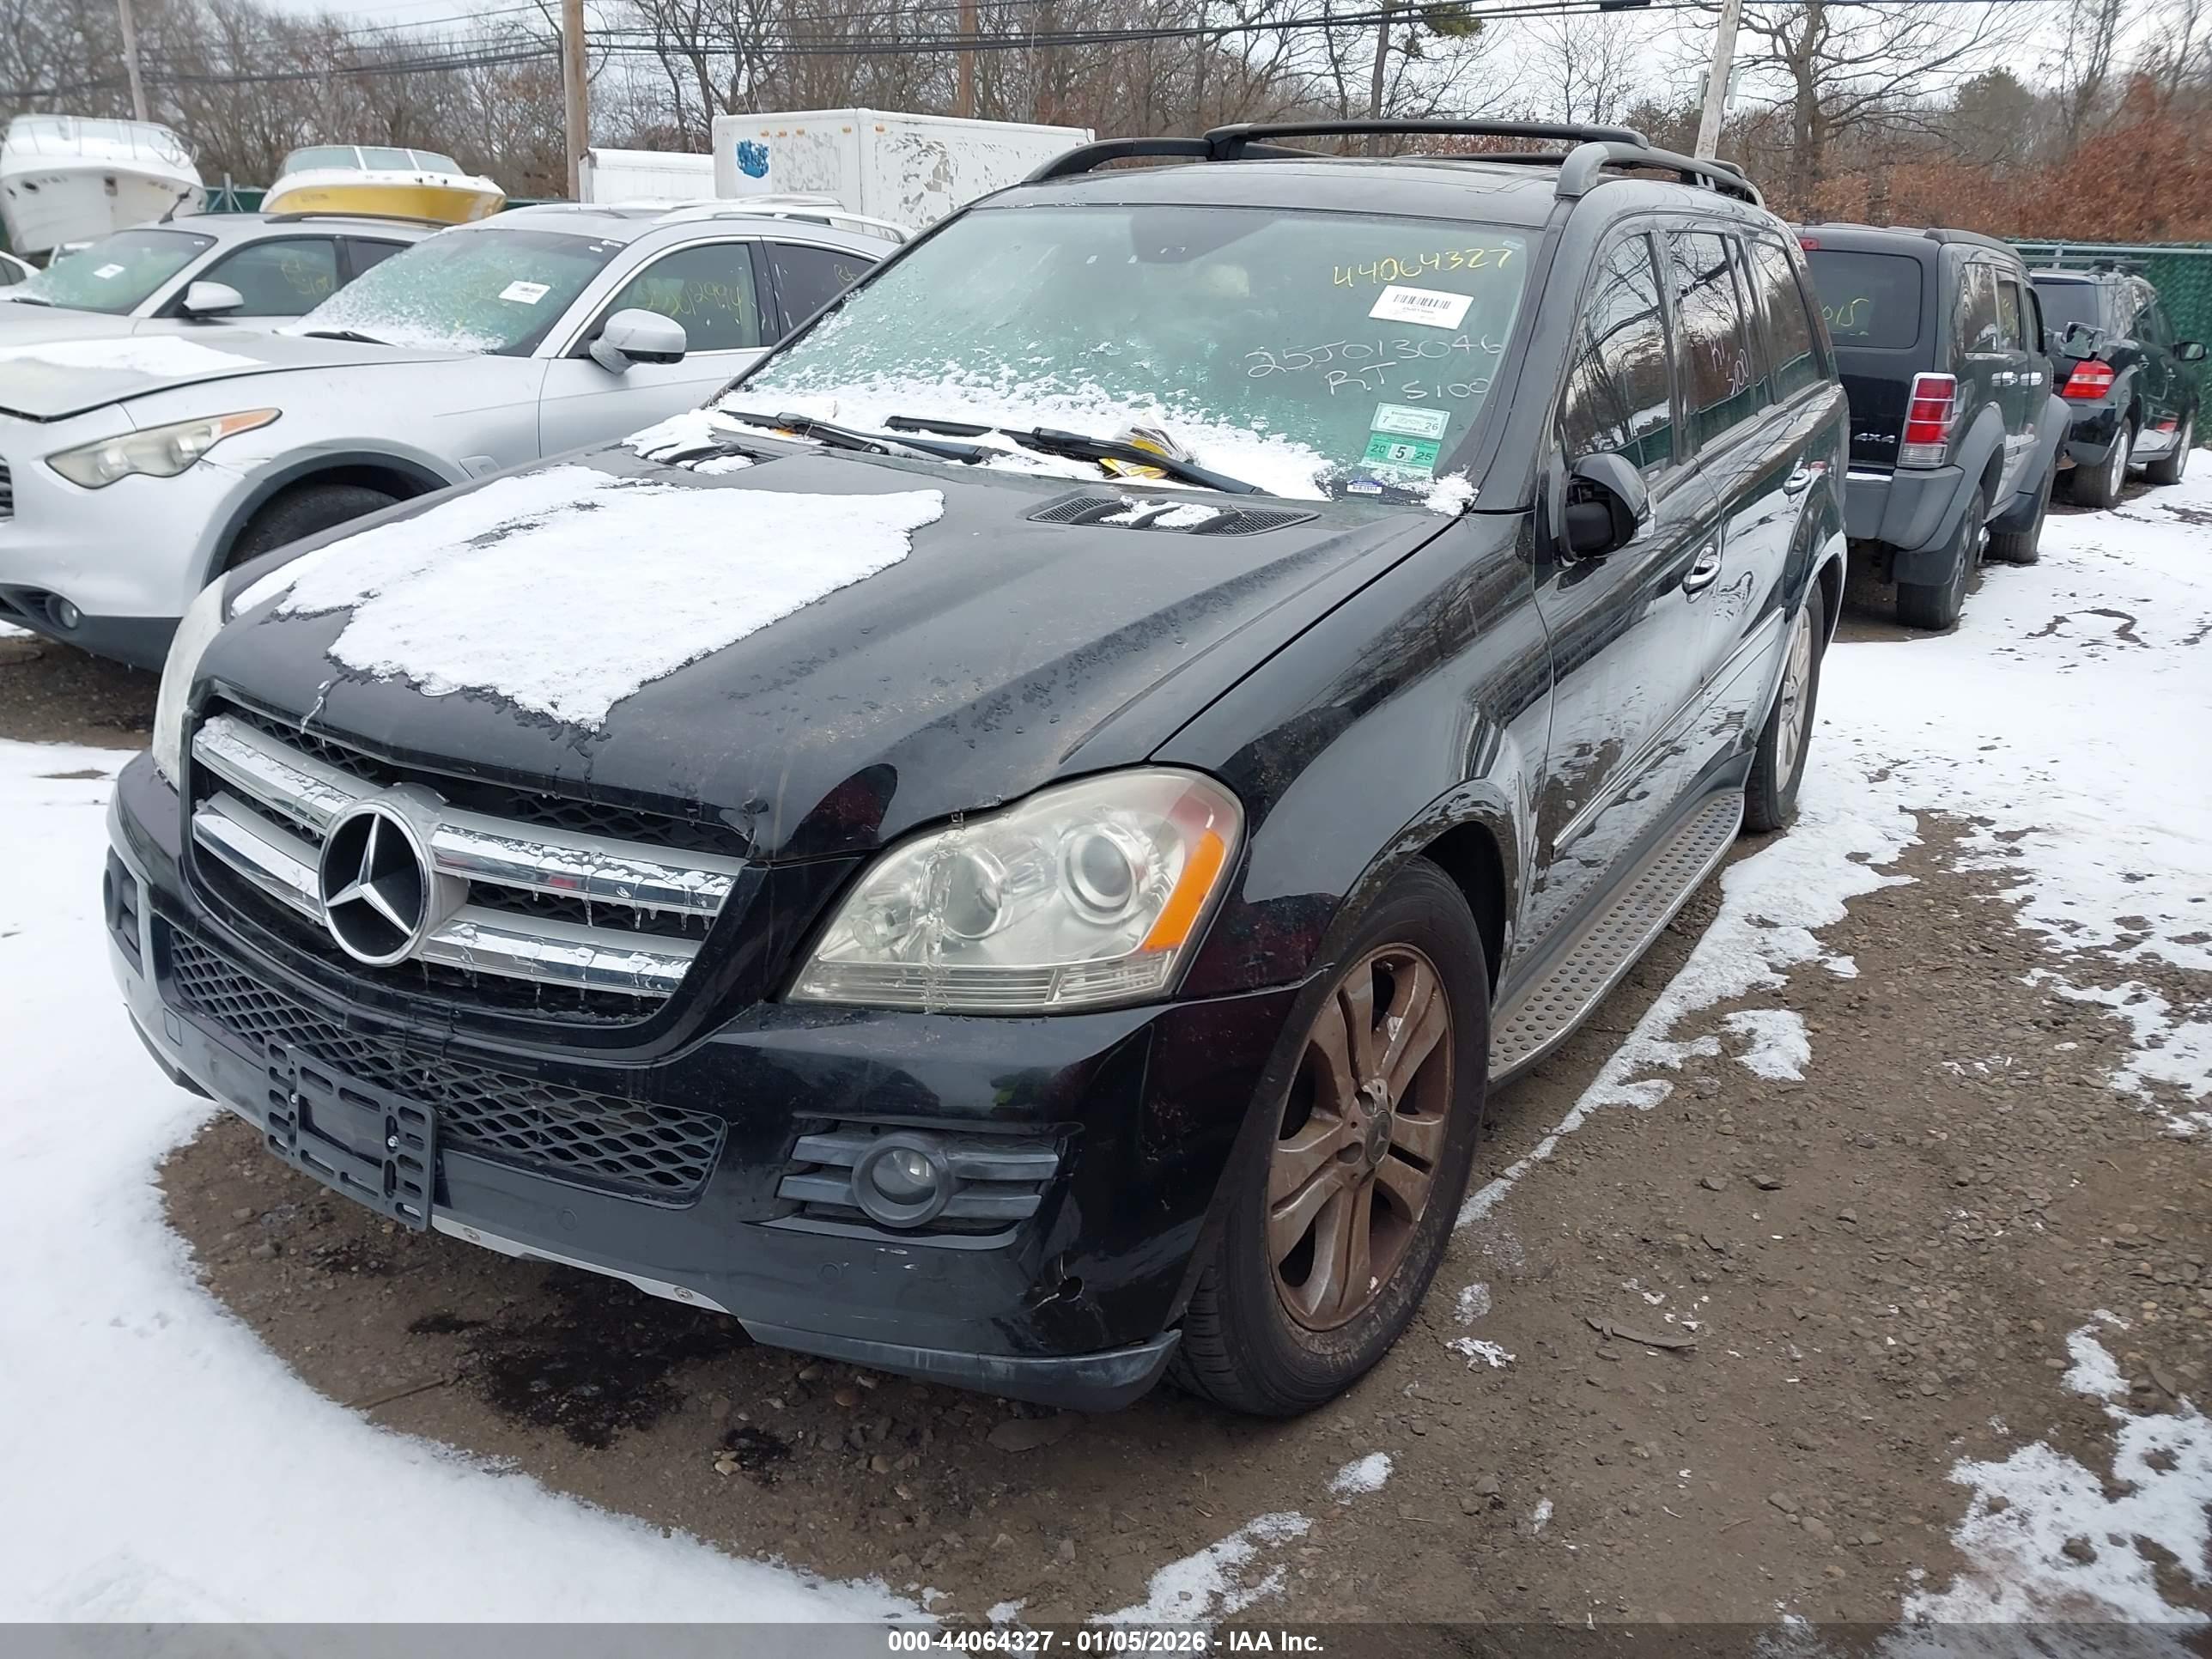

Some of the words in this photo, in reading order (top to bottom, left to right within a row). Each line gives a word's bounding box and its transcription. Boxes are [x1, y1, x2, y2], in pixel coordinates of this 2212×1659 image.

[1334, 248, 1514, 288] 44064327
[1425, 422, 1439, 431] 26
[1370, 444, 1387, 453] 20
[1395, 446, 1407, 459] 5
[1415, 452, 1433, 461] 25
